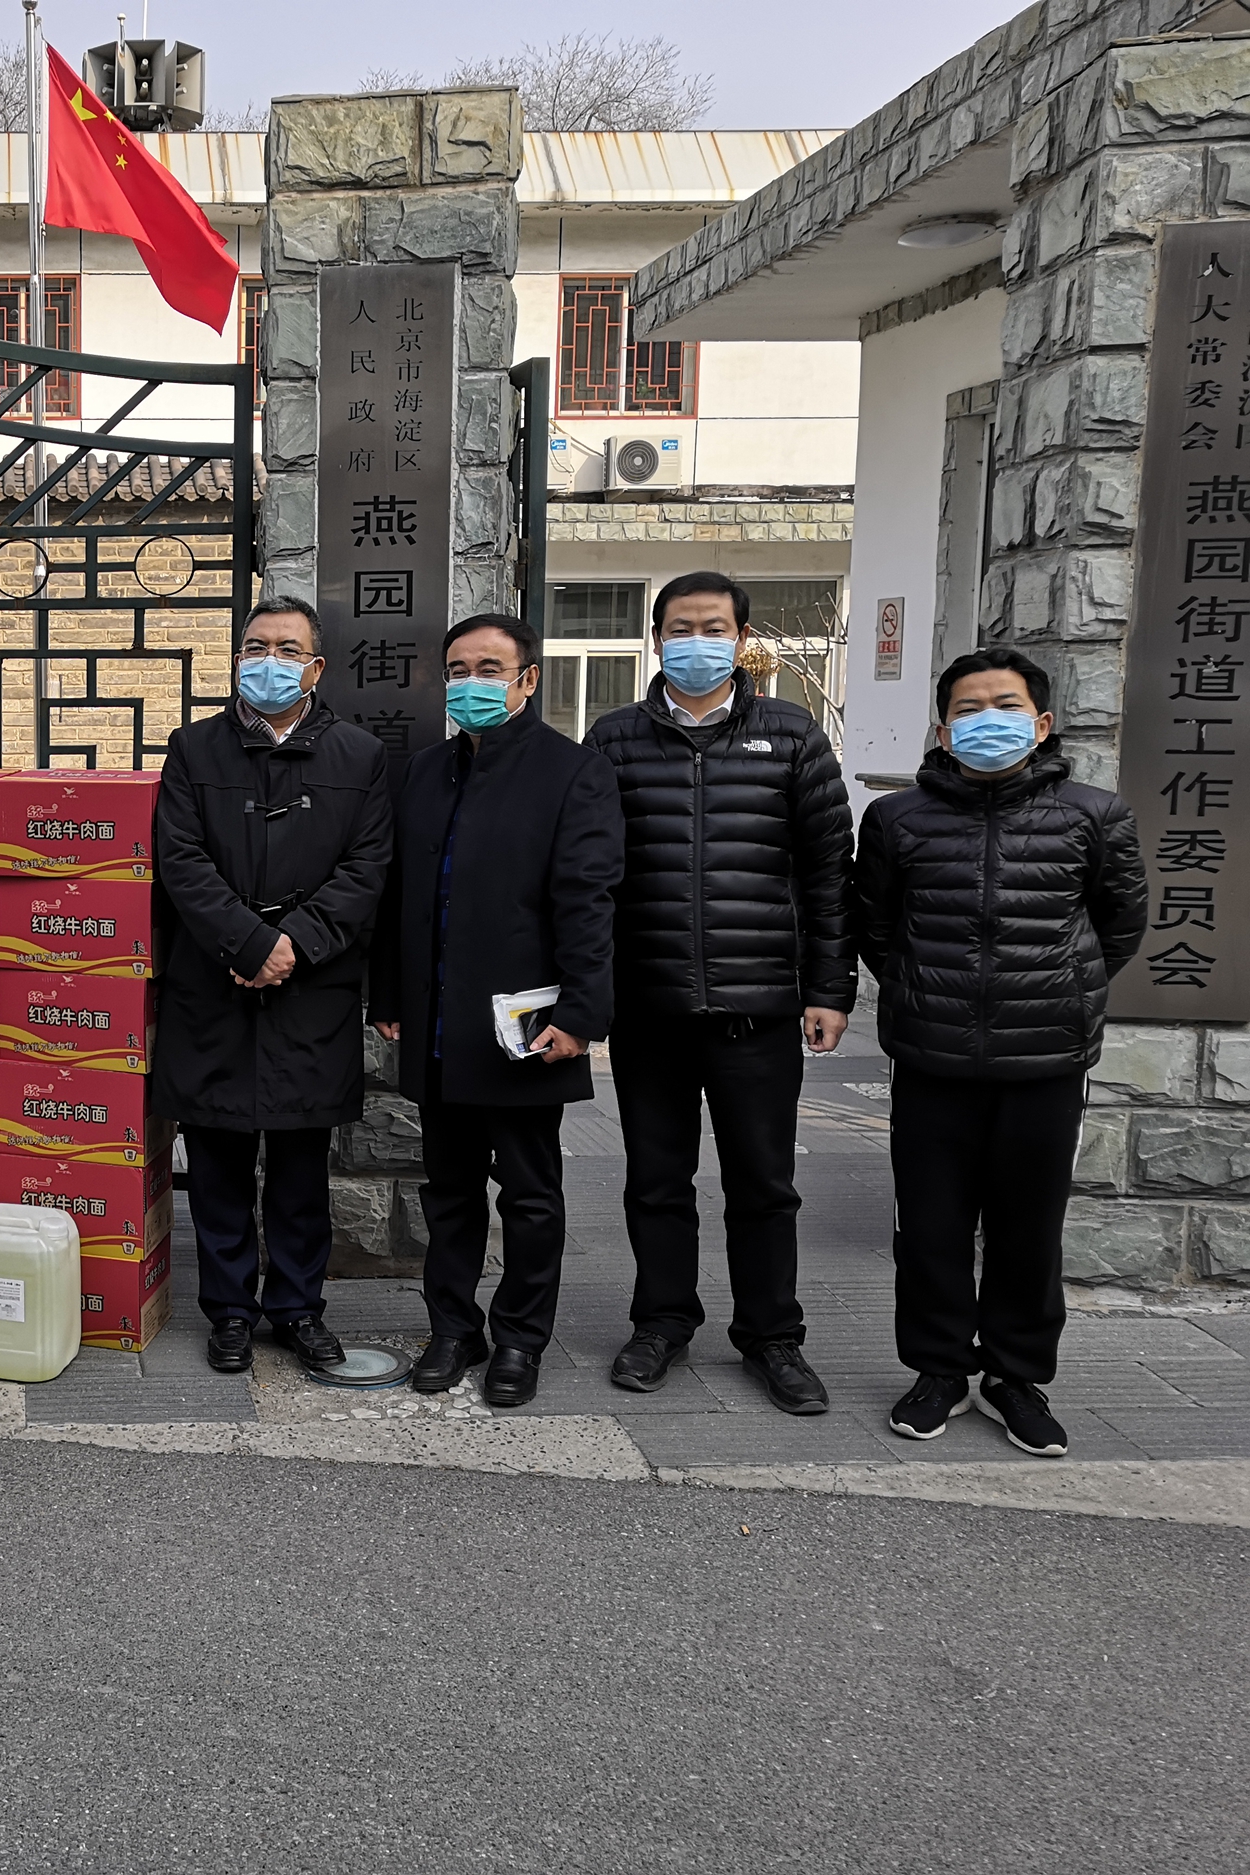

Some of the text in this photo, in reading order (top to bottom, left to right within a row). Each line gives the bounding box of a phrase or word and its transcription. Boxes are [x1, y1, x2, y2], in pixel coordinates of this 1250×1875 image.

[347, 299, 377, 474] 人民政府
[394, 297, 424, 474] 北京市海淀区
[1179, 252, 1234, 451] 人大常委会
[1146, 475, 1250, 989] 燕园街道工作委员会
[28, 820, 115, 841] 红烧牛肉面
[31, 915, 116, 937] 红烧牛肉面
[28, 1005, 110, 1029] 红烧牛肉面
[23, 1098, 108, 1123] 红烧牛肉面
